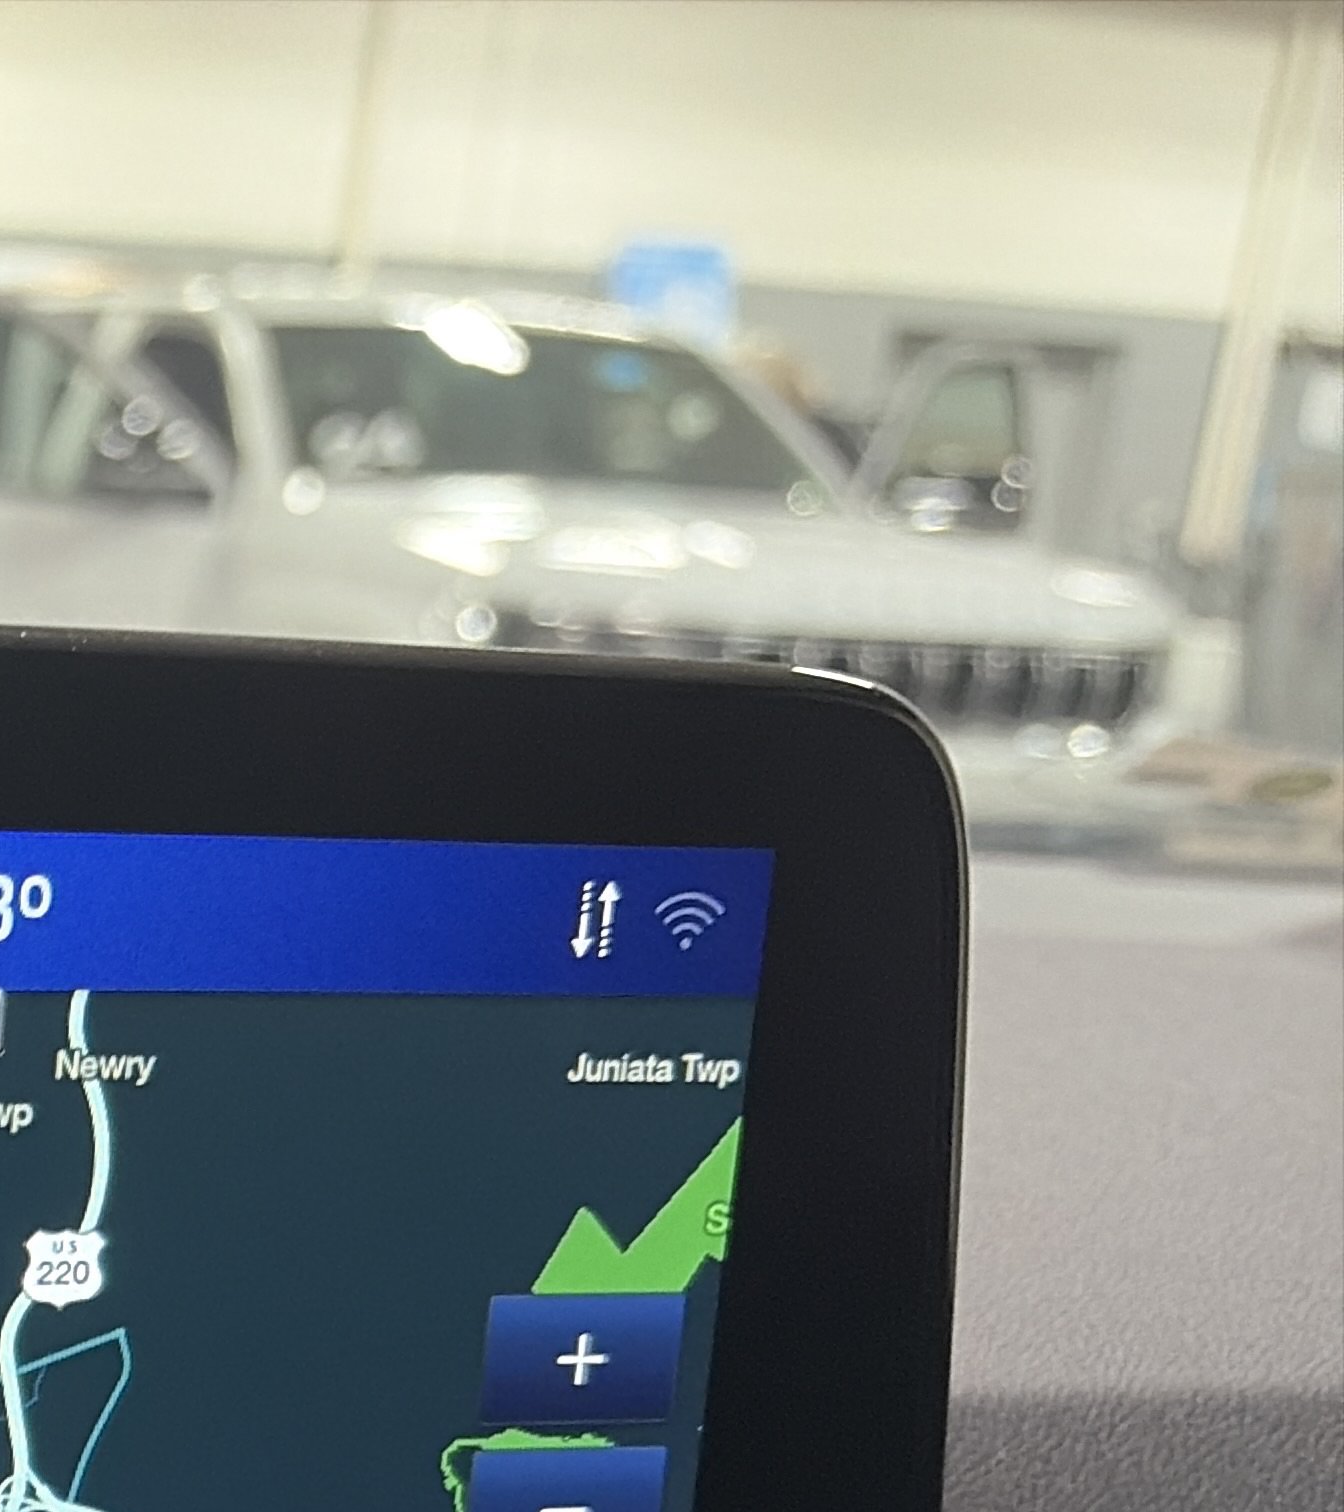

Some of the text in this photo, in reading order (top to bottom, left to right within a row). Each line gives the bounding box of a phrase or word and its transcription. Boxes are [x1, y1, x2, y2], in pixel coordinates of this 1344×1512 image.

[54, 1050, 157, 1086] Newry
[567, 1053, 740, 1089] Juniata Twp
[36, 1260, 90, 1286] 220
